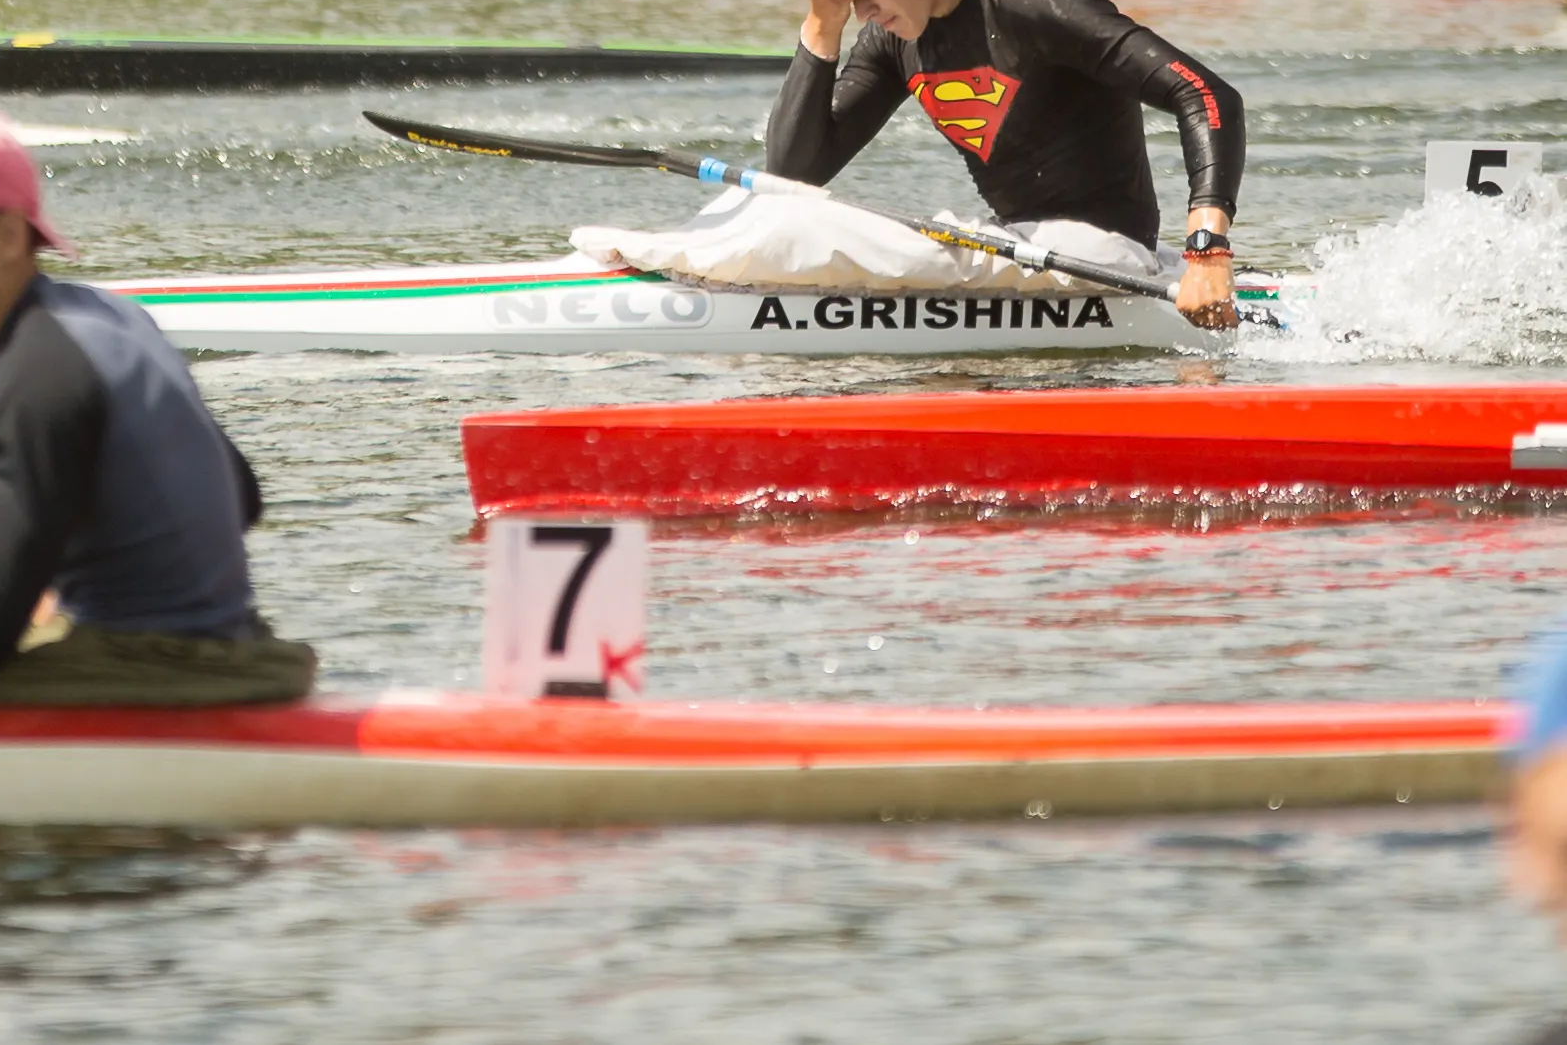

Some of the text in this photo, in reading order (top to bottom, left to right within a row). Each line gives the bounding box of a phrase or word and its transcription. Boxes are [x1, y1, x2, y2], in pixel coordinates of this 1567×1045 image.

[1466, 149, 1508, 198] 5
[493, 291, 708, 325] NELO
[750, 295, 1114, 330] A.GRISHINA
[530, 526, 614, 655] 7
[599, 635, 646, 695] K
